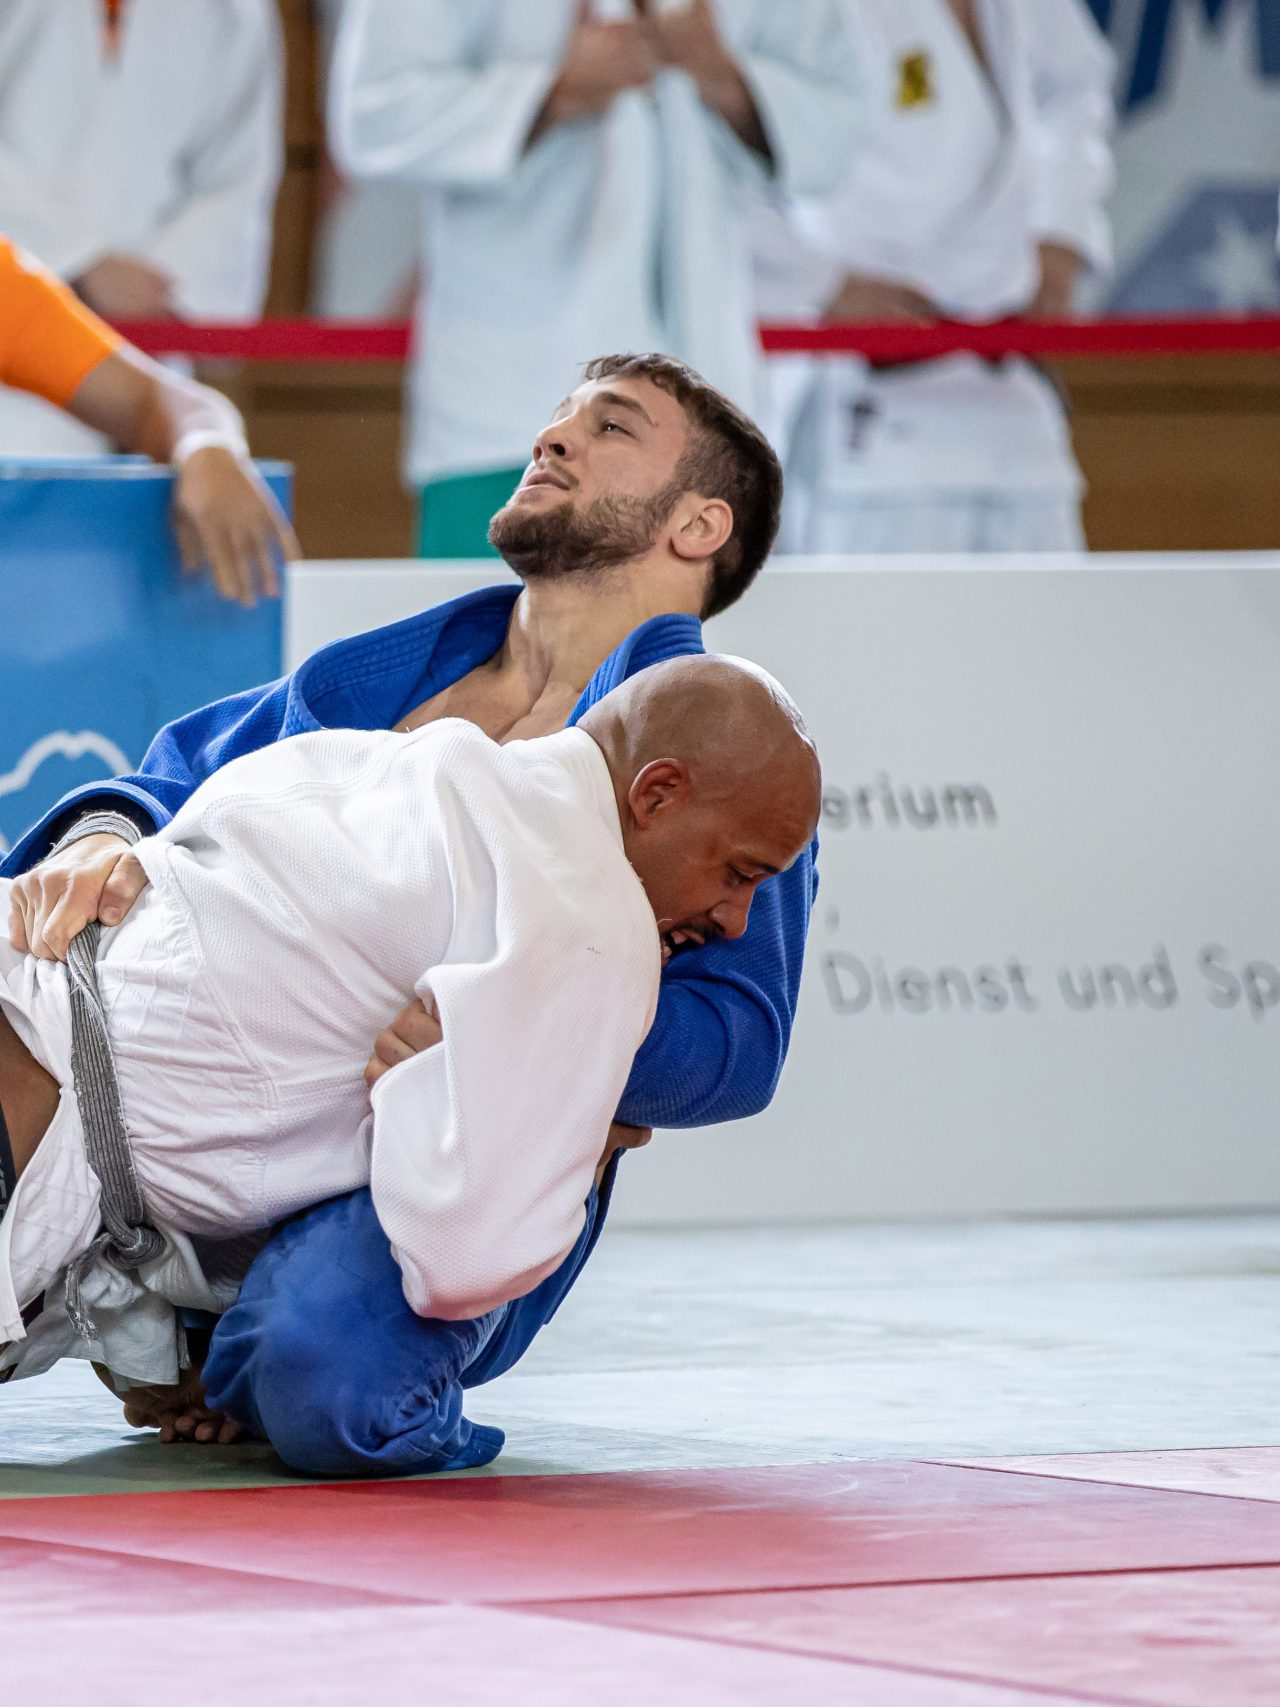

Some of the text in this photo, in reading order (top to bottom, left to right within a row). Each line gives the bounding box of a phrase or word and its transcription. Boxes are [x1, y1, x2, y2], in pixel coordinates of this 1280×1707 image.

[821, 941, 1280, 1025] Dienst und Sp
